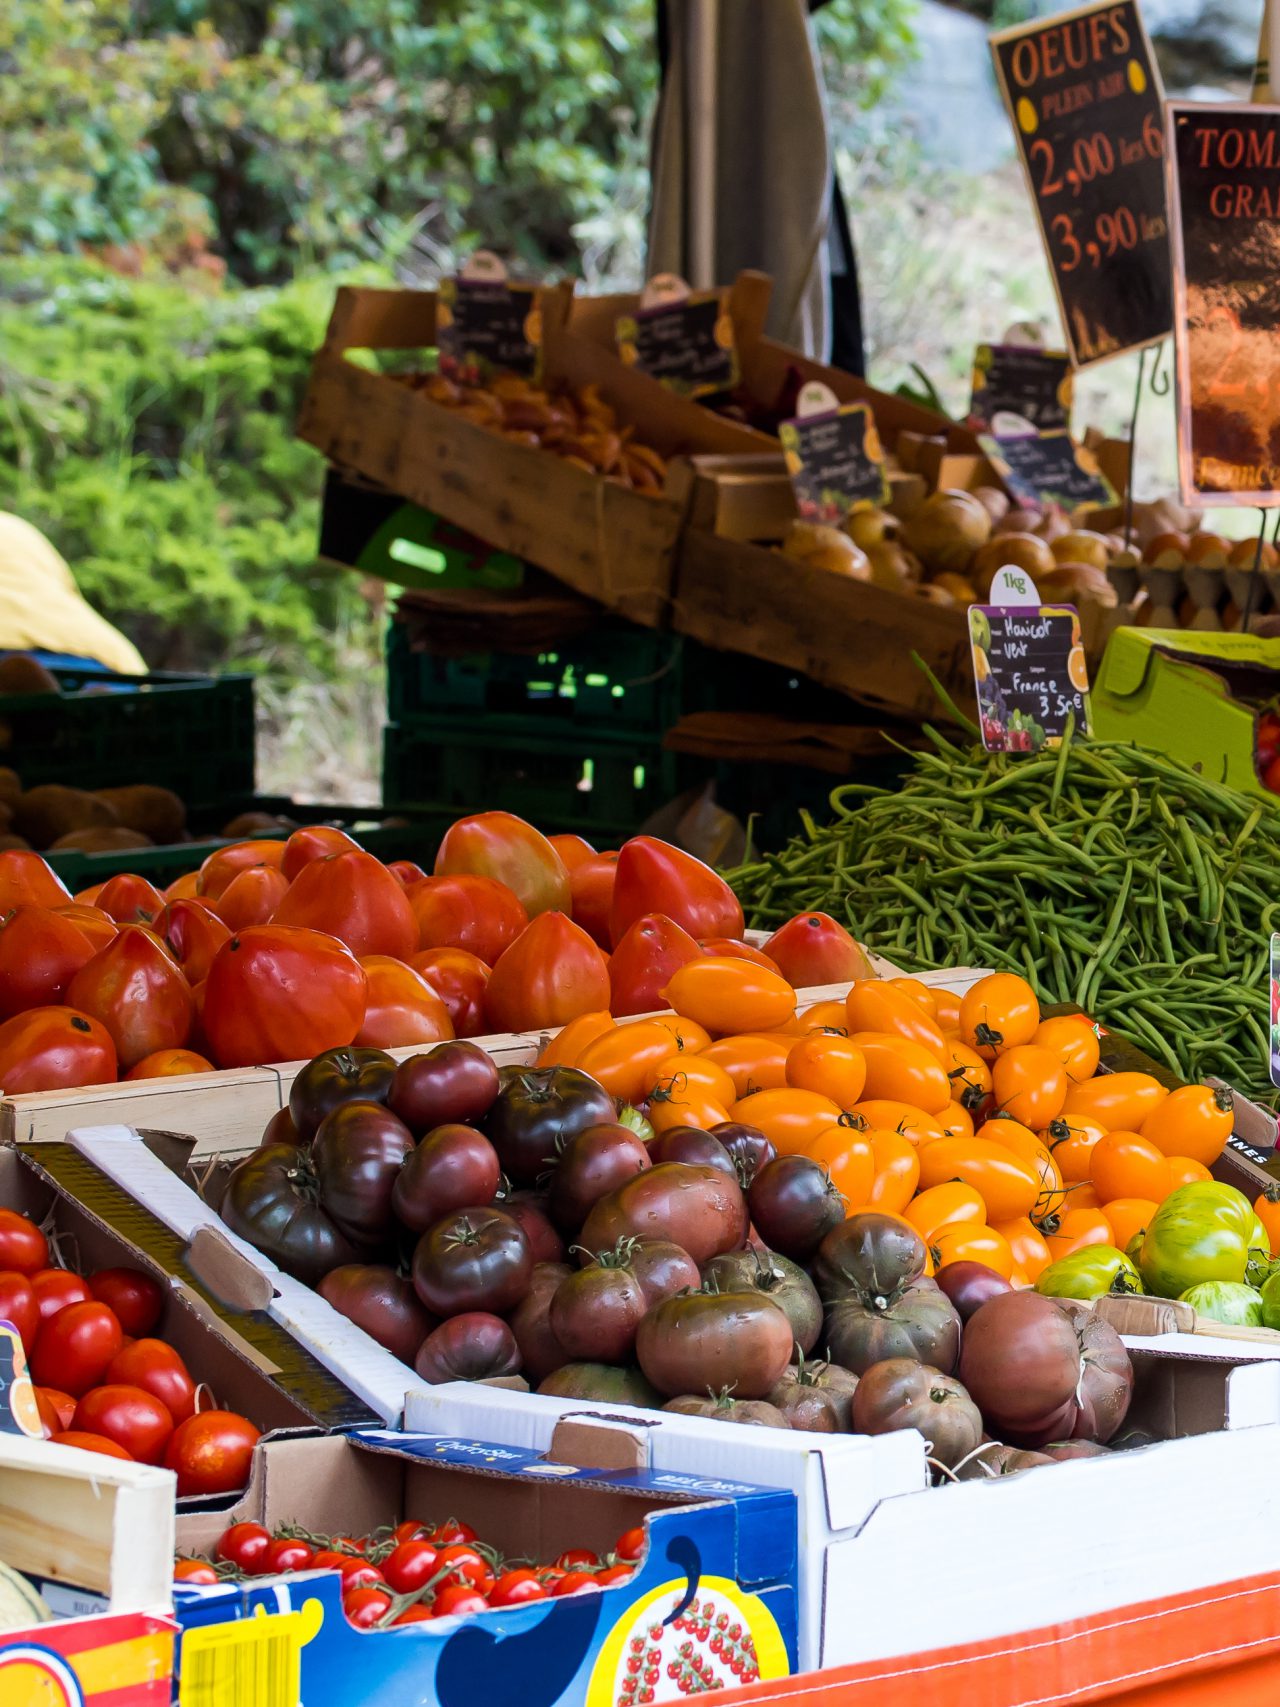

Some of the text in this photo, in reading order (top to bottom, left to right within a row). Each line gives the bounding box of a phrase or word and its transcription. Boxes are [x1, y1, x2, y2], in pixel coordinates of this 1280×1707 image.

[1012, 8, 1130, 87] OEUFS
[1030, 131, 1114, 197] 2,00
[1051, 206, 1138, 271] 3,90
[1003, 572, 1026, 595] 1kg
[1012, 672, 1058, 694] France
